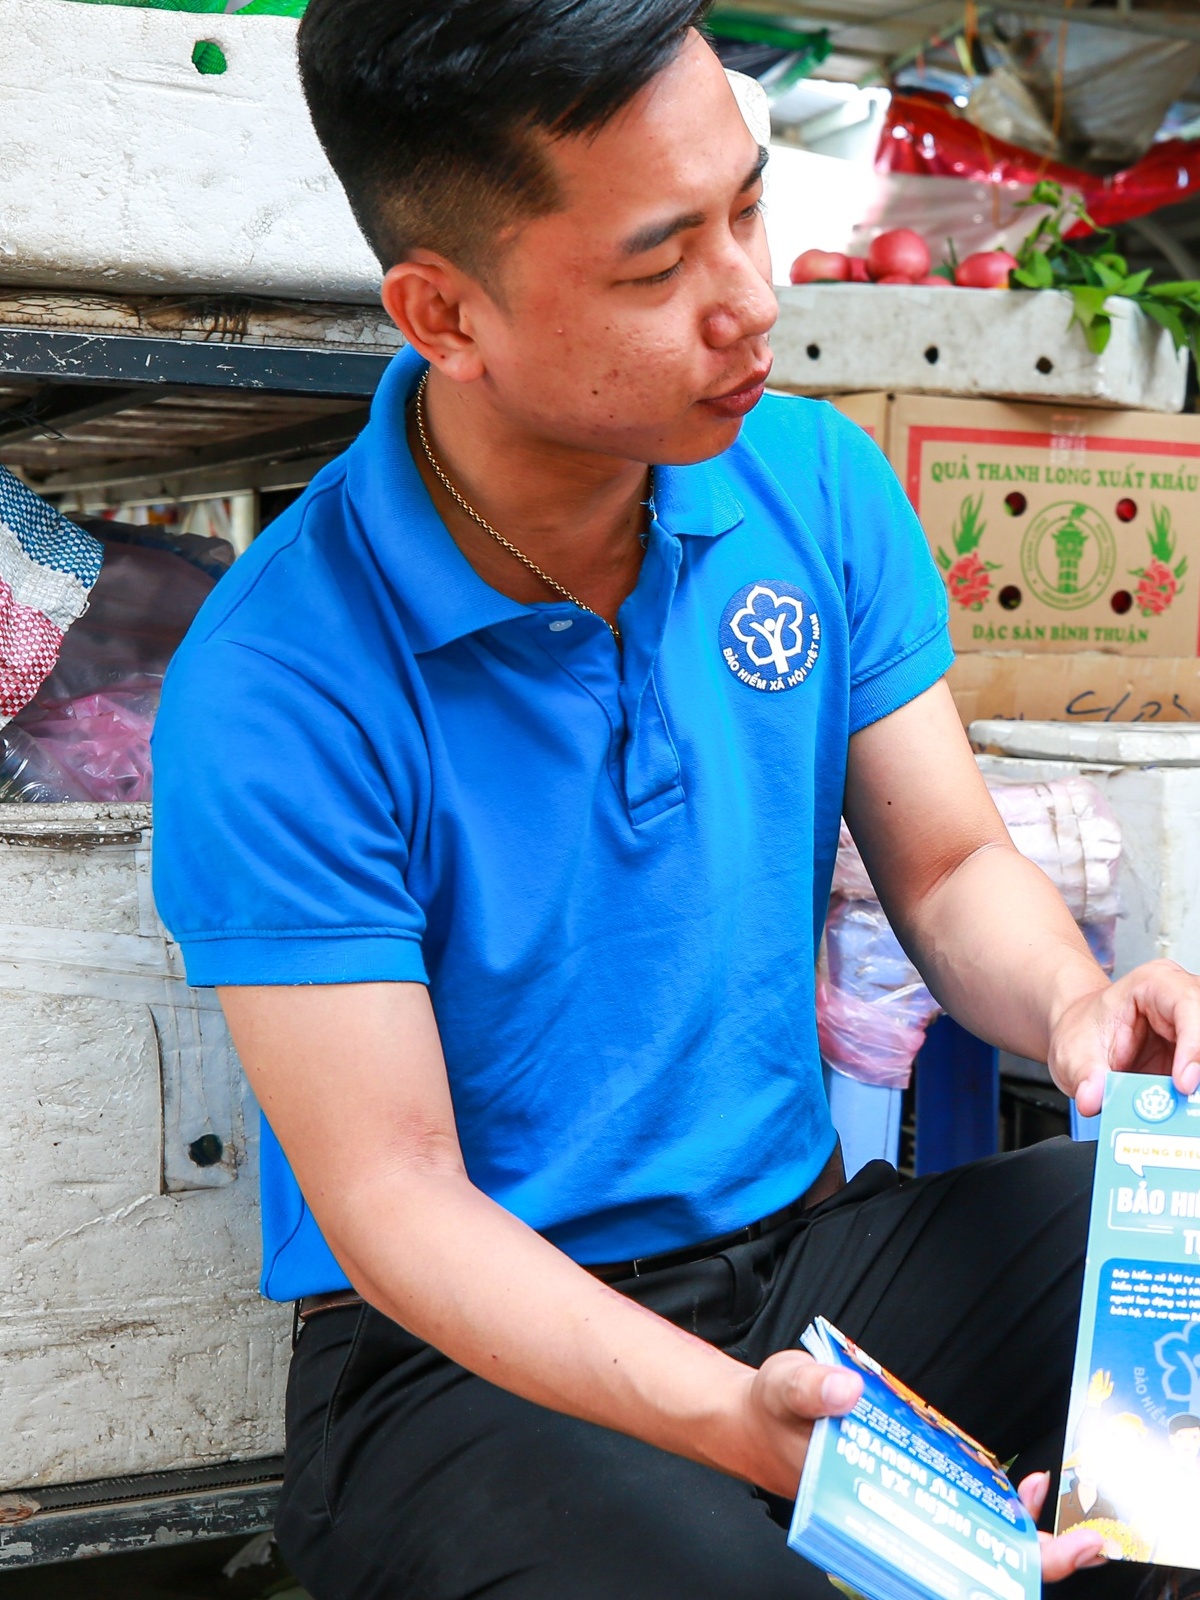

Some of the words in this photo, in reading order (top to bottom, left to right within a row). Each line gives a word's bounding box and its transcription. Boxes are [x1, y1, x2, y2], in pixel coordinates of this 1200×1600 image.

[931, 454, 970, 483] QUẢ
[977, 463, 1040, 483] THANH
[1045, 466, 1091, 485] LONG
[1096, 462, 1145, 489] XUẤT
[809, 613, 820, 640] NAM
[1012, 619, 1046, 641] SẢN
[1051, 622, 1089, 641] BÌNH
[1094, 624, 1149, 645] THUẬN
[722, 647, 740, 671] BẢO
[804, 641, 819, 669] VIỆT
[737, 668, 767, 690] HIỂM
[769, 677, 786, 691] XÃ
[787, 667, 807, 687] HỘI
[1116, 1180, 1166, 1216] BẢO
[1134, 1367, 1149, 1395] BẢO
[836, 1437, 876, 1475] HỘI
[841, 1418, 928, 1486] NGUYỆN
[880, 1464, 911, 1498] XÃ
[929, 1477, 959, 1507] TỰ
[976, 1527, 1020, 1569] BẢO
